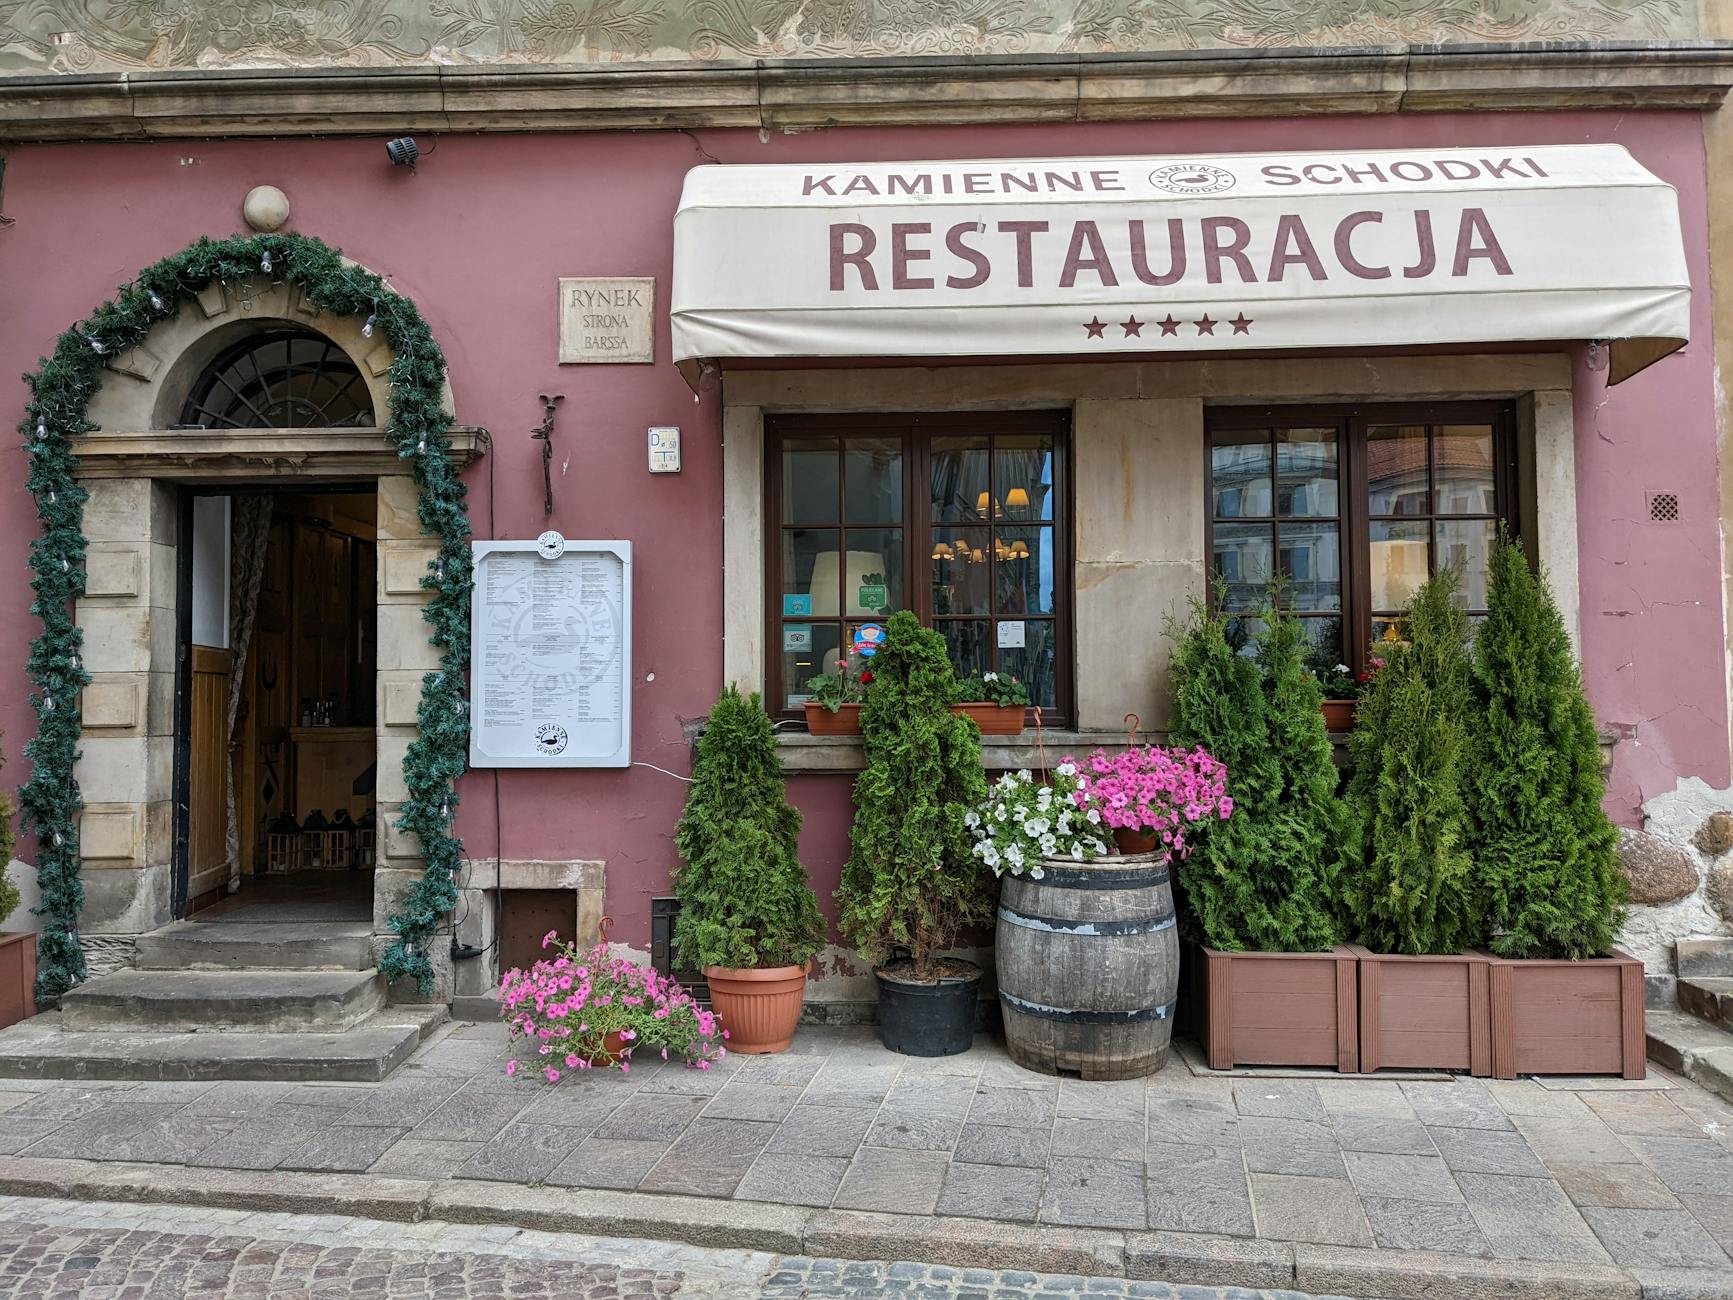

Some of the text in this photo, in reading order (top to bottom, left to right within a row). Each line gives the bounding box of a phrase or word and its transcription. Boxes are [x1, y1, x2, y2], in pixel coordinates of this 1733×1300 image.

[802, 158, 1549, 195] KAMIENNE SCHODKI
[829, 208, 1514, 291] RESTAURACJA
[571, 289, 643, 307] RYNEK
[583, 314, 629, 328] STRONA
[584, 336, 629, 350] BARSSA
[651, 433, 660, 446] D
[536, 724, 566, 739] KAMIENNE
